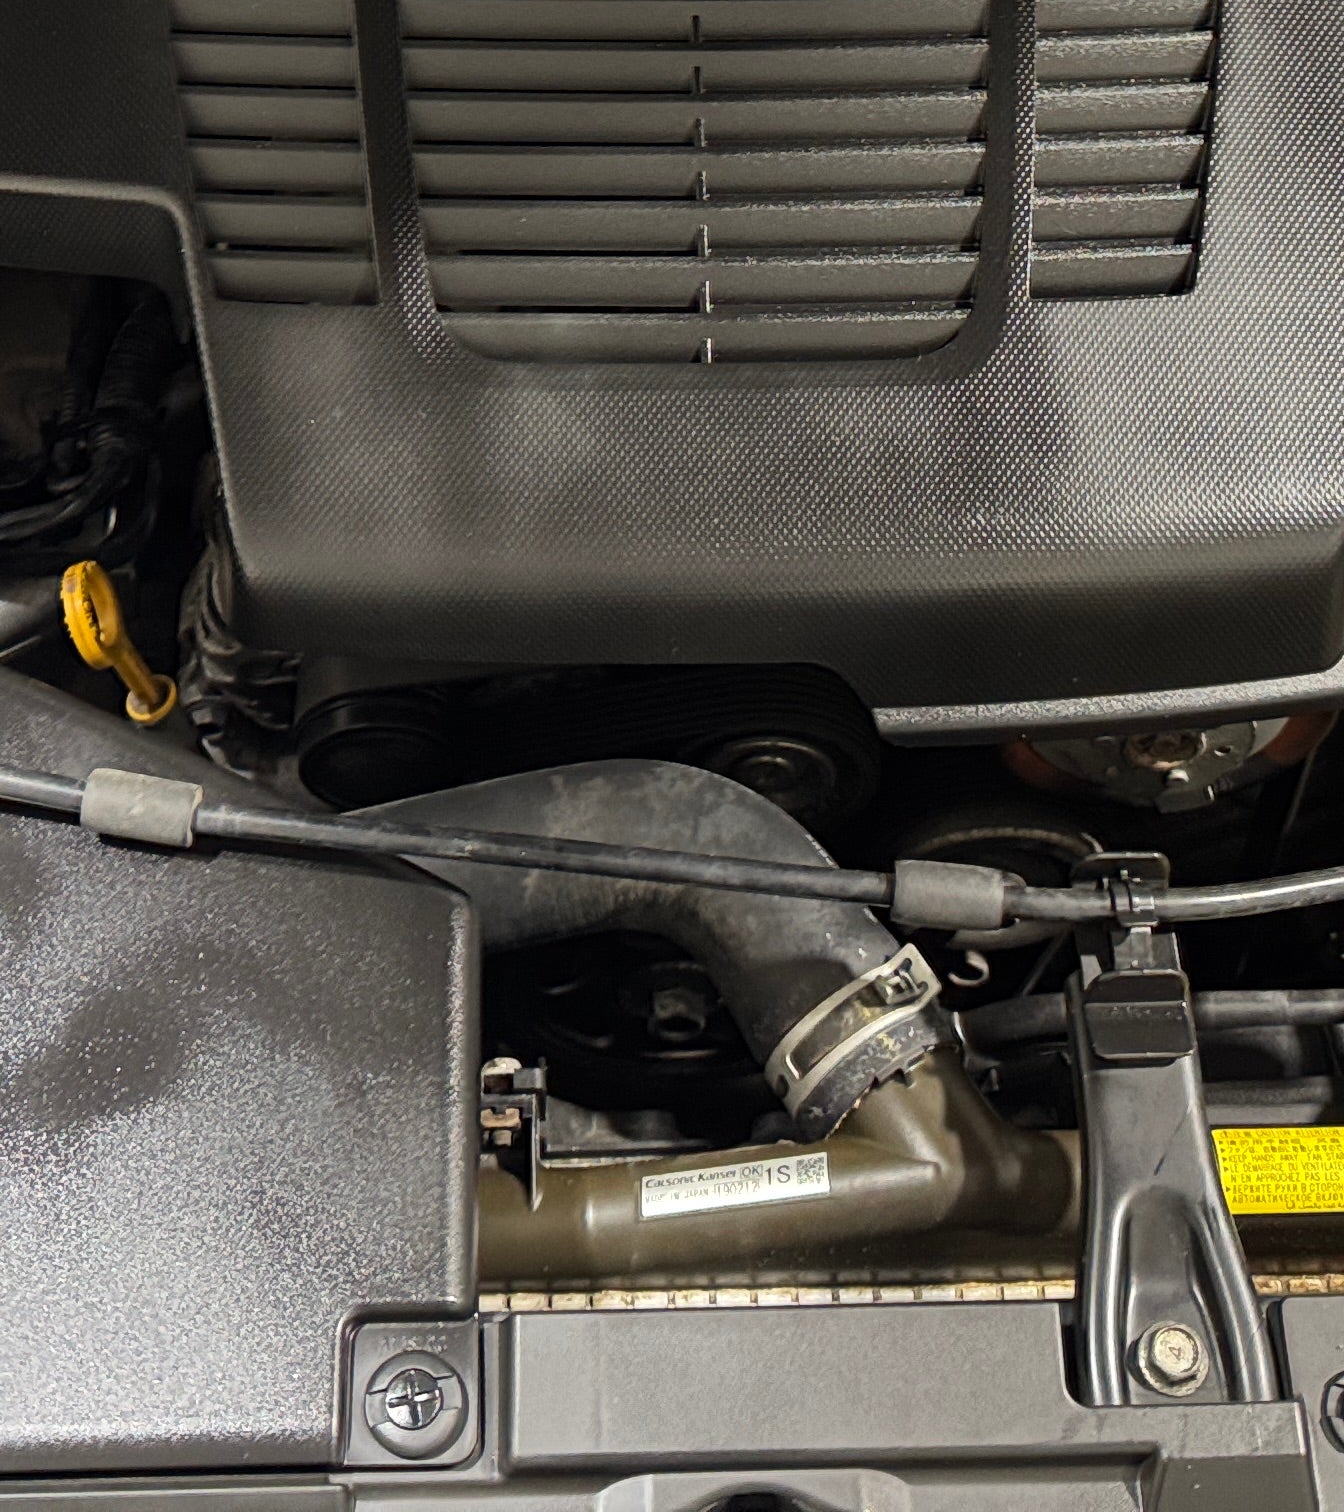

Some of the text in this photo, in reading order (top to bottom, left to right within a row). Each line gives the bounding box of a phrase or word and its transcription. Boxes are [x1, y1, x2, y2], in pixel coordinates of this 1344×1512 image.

[1228, 1154, 1247, 1163] KEEP
[1251, 1154, 1275, 1162] HANDS
[740, 1164, 763, 1179] OK
[1288, 1163, 1298, 1171] DU
[1255, 1172, 1301, 1183] APPROCHEZ
[1304, 1172, 1321, 1181] PAS
[1325, 1171, 1340, 1181] LES
